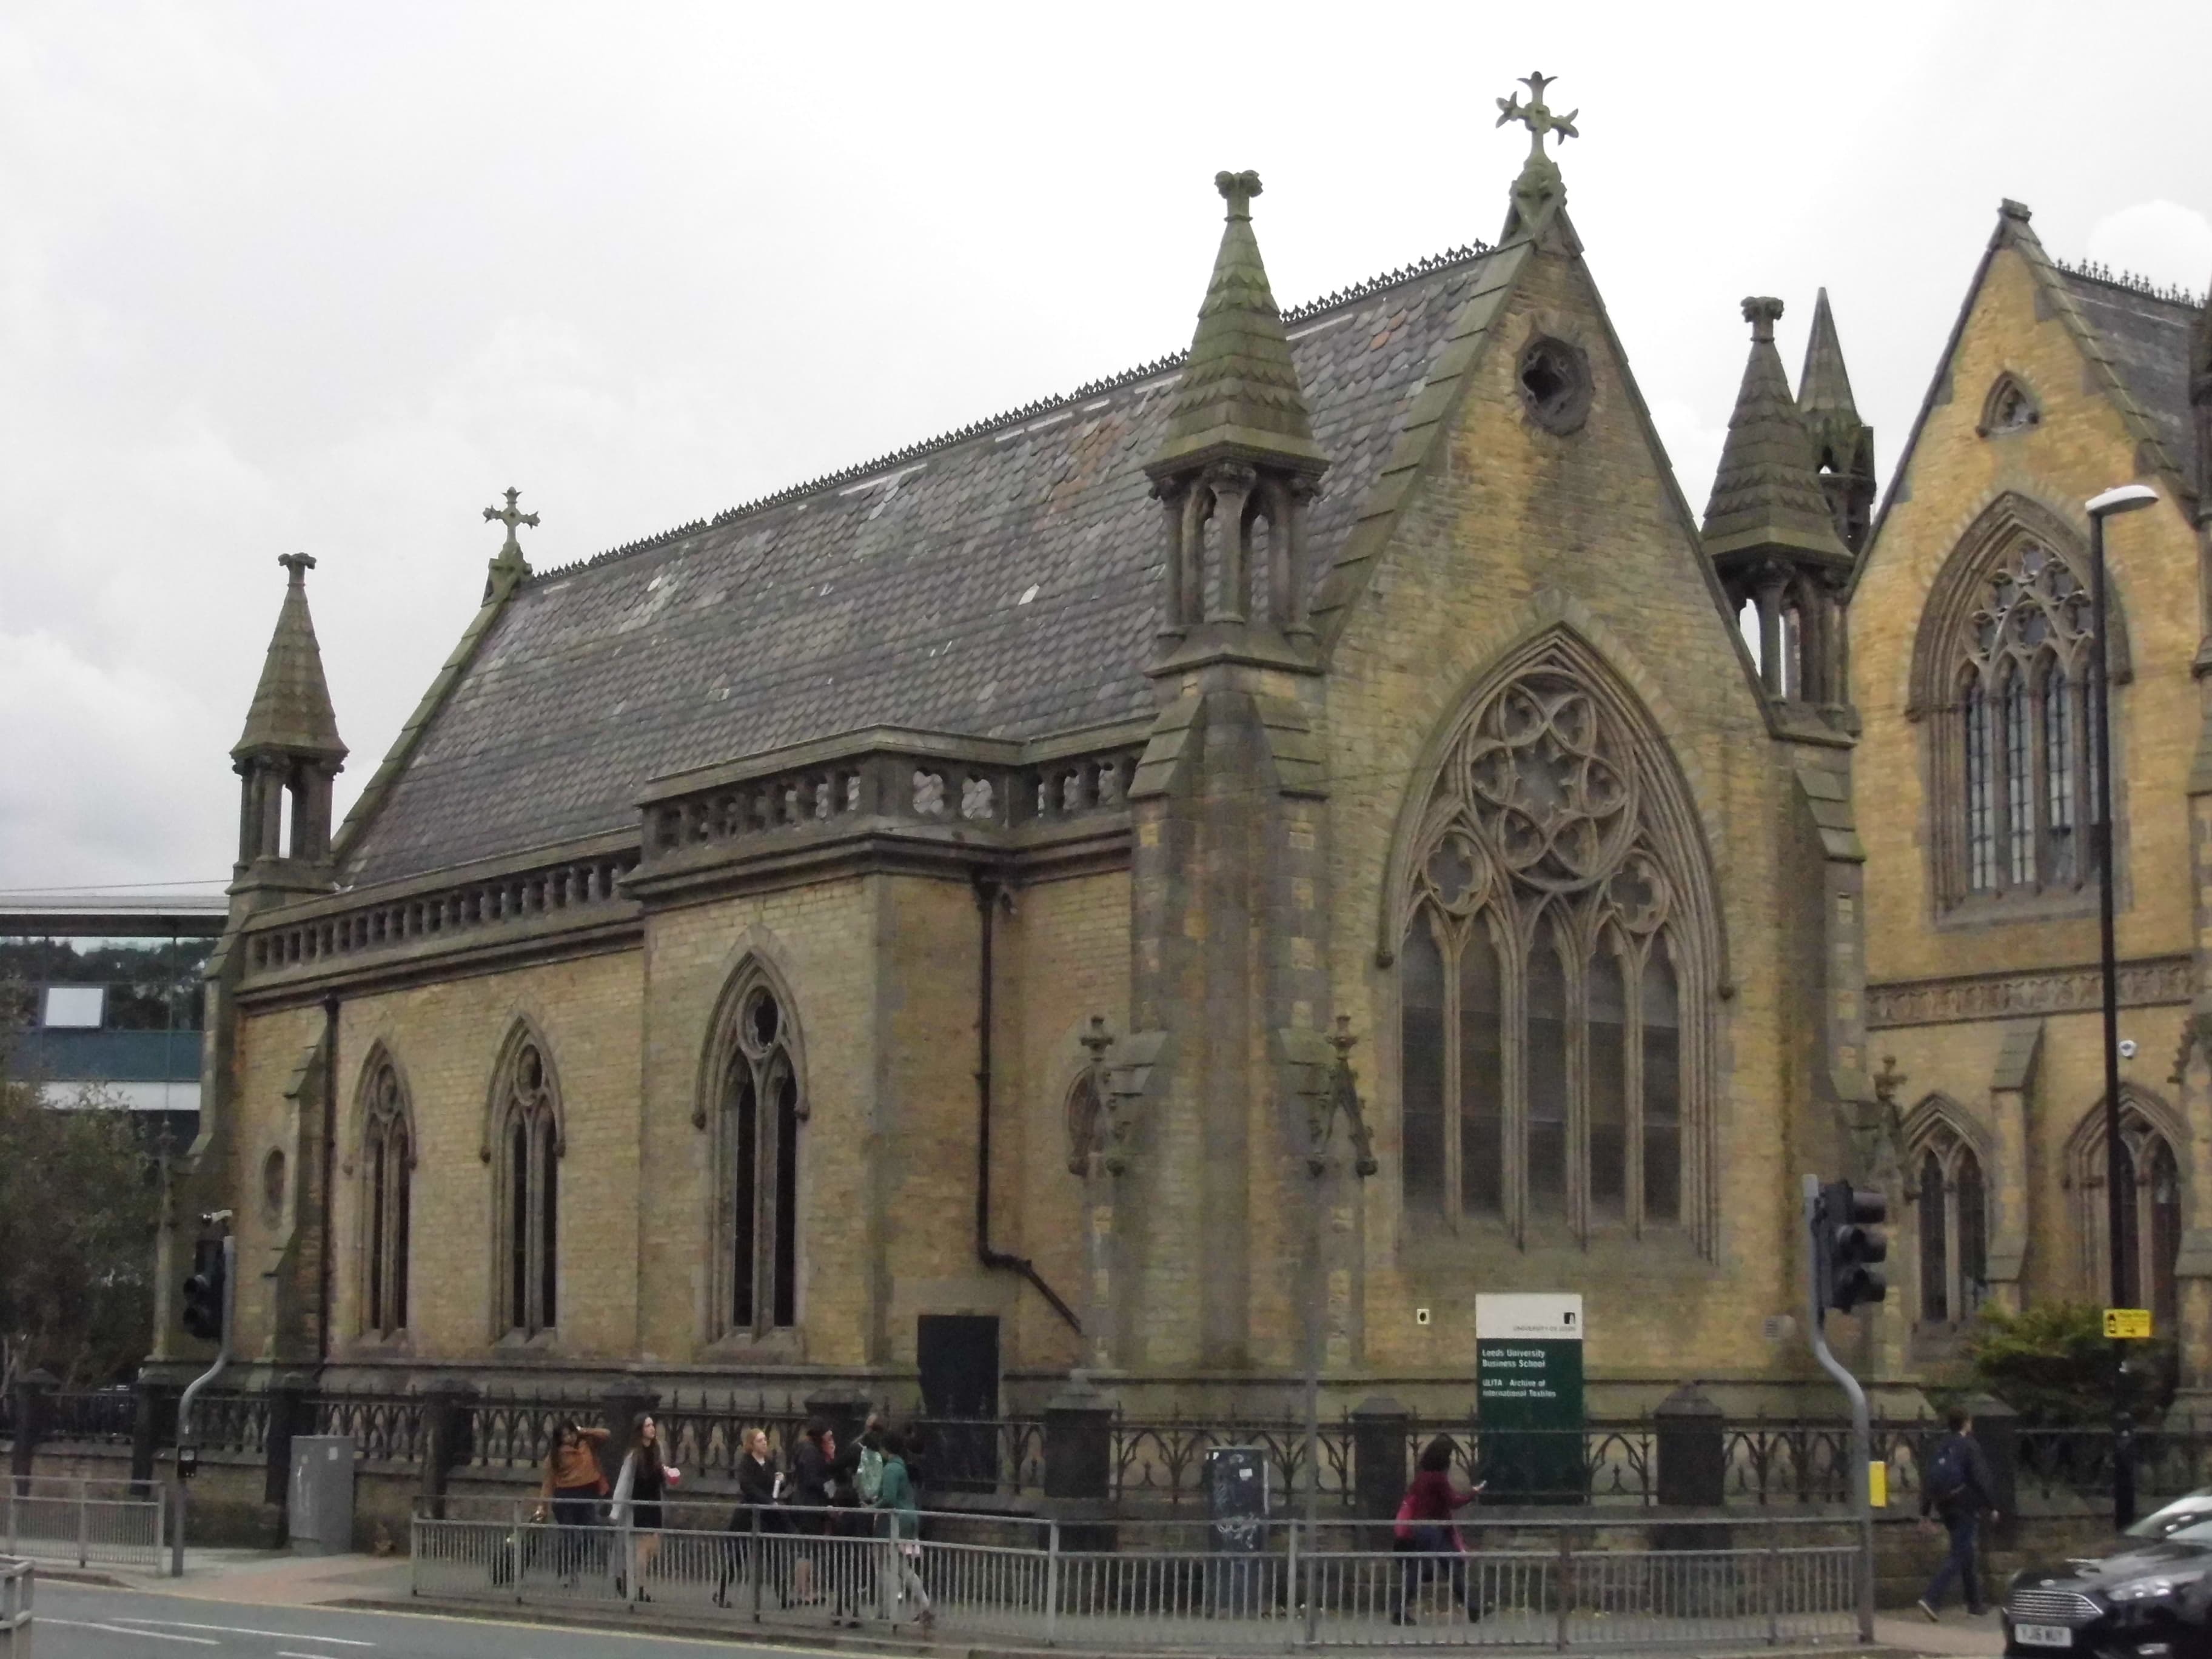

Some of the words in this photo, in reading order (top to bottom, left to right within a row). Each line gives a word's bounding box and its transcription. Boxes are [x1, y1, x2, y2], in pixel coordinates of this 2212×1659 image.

[1482, 1349, 1504, 1357] Leeds
[1506, 1349, 1545, 1358] University
[1483, 1359, 1517, 1367] Business
[1518, 1359, 1546, 1367] School
